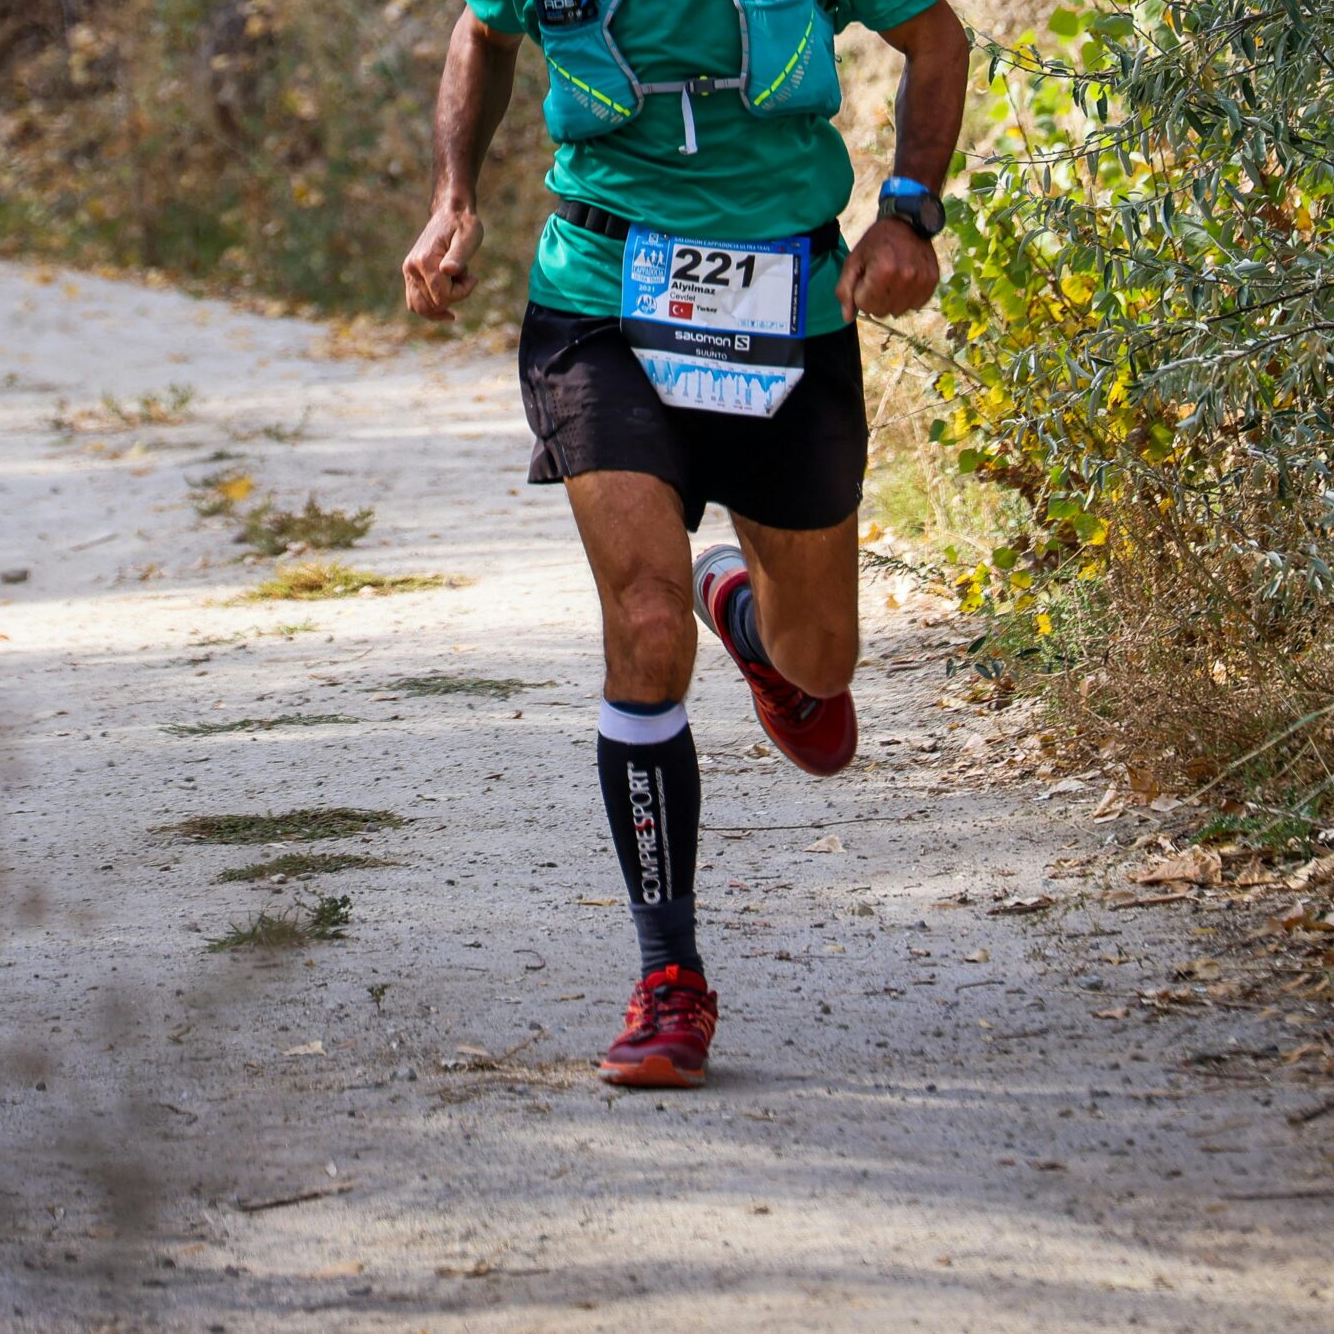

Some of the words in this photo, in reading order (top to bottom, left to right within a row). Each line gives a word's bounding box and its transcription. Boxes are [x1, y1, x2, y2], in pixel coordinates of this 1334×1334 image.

[671, 248, 756, 288] 221
[638, 284, 655, 293] 2021
[670, 292, 696, 302] Cevdet
[696, 305, 717, 314] Turkey
[695, 348, 728, 361] SUUNTO
